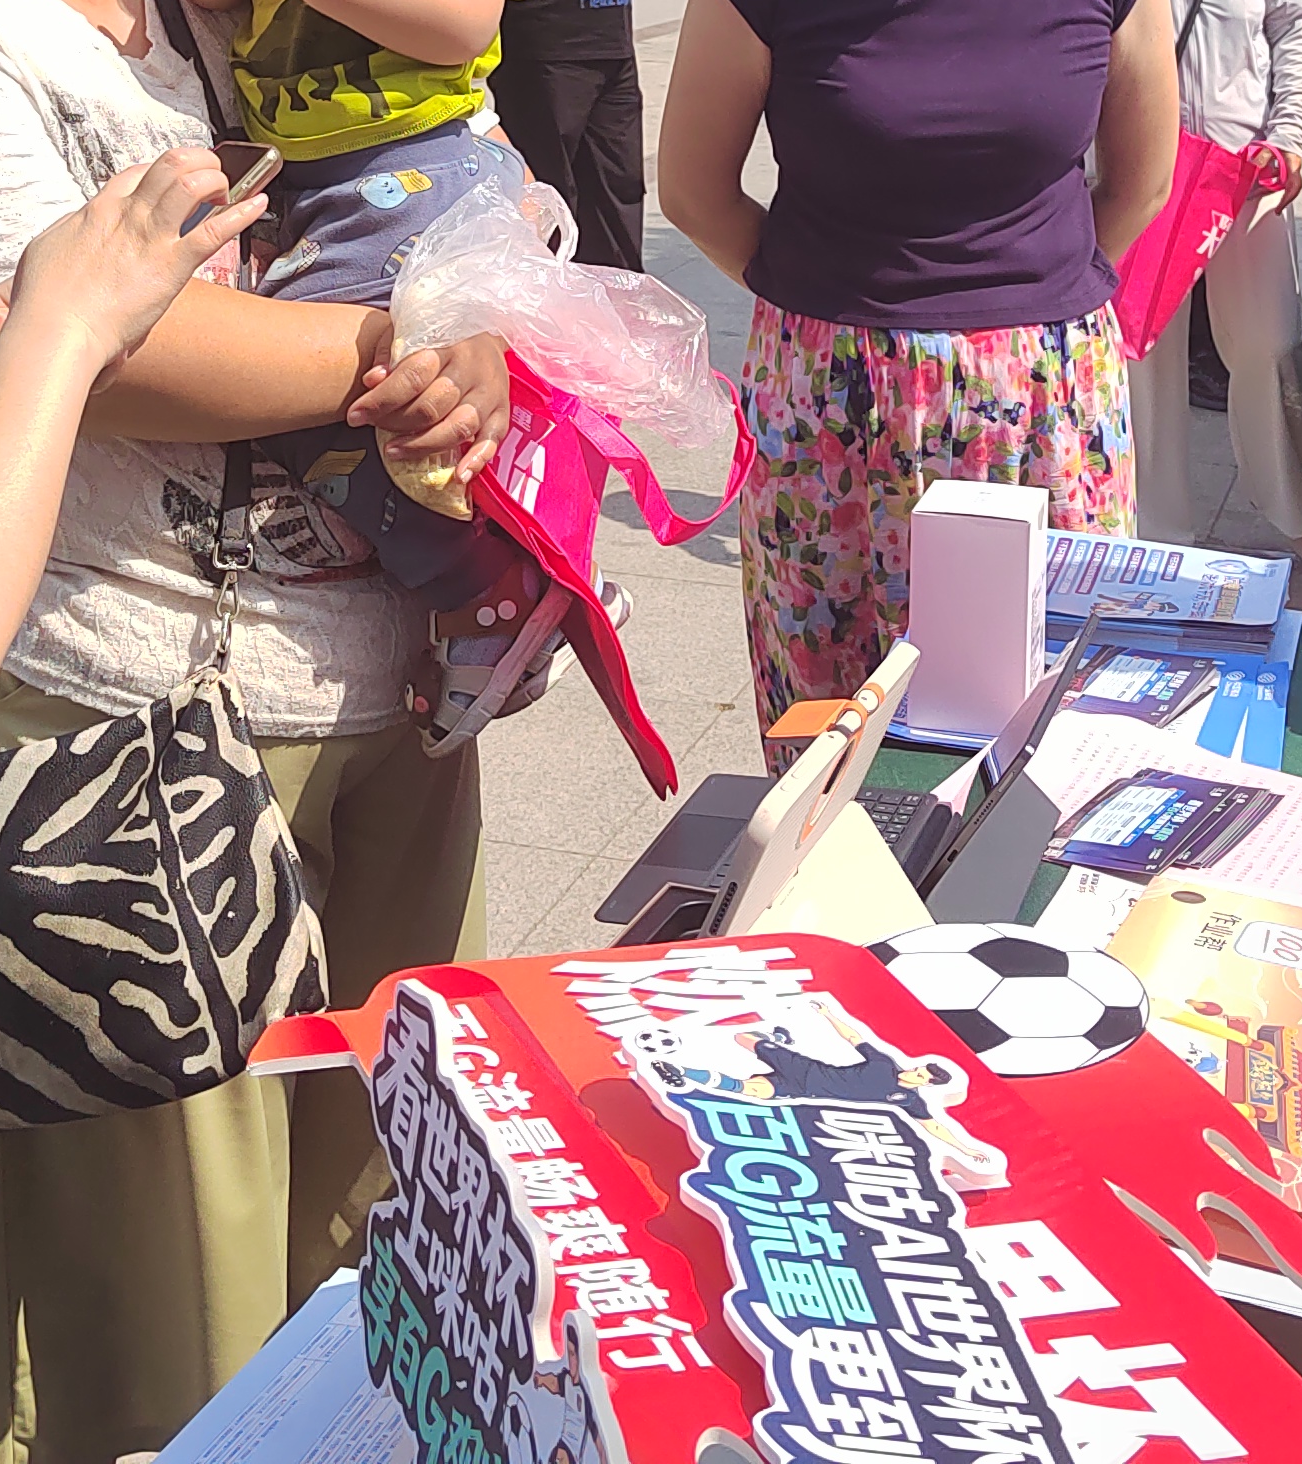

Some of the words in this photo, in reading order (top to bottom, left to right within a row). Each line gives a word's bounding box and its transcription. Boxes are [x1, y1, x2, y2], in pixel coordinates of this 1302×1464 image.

[375, 1014, 531, 1360] 看世界杯
[395, 1178, 504, 1428] 上咪咕
